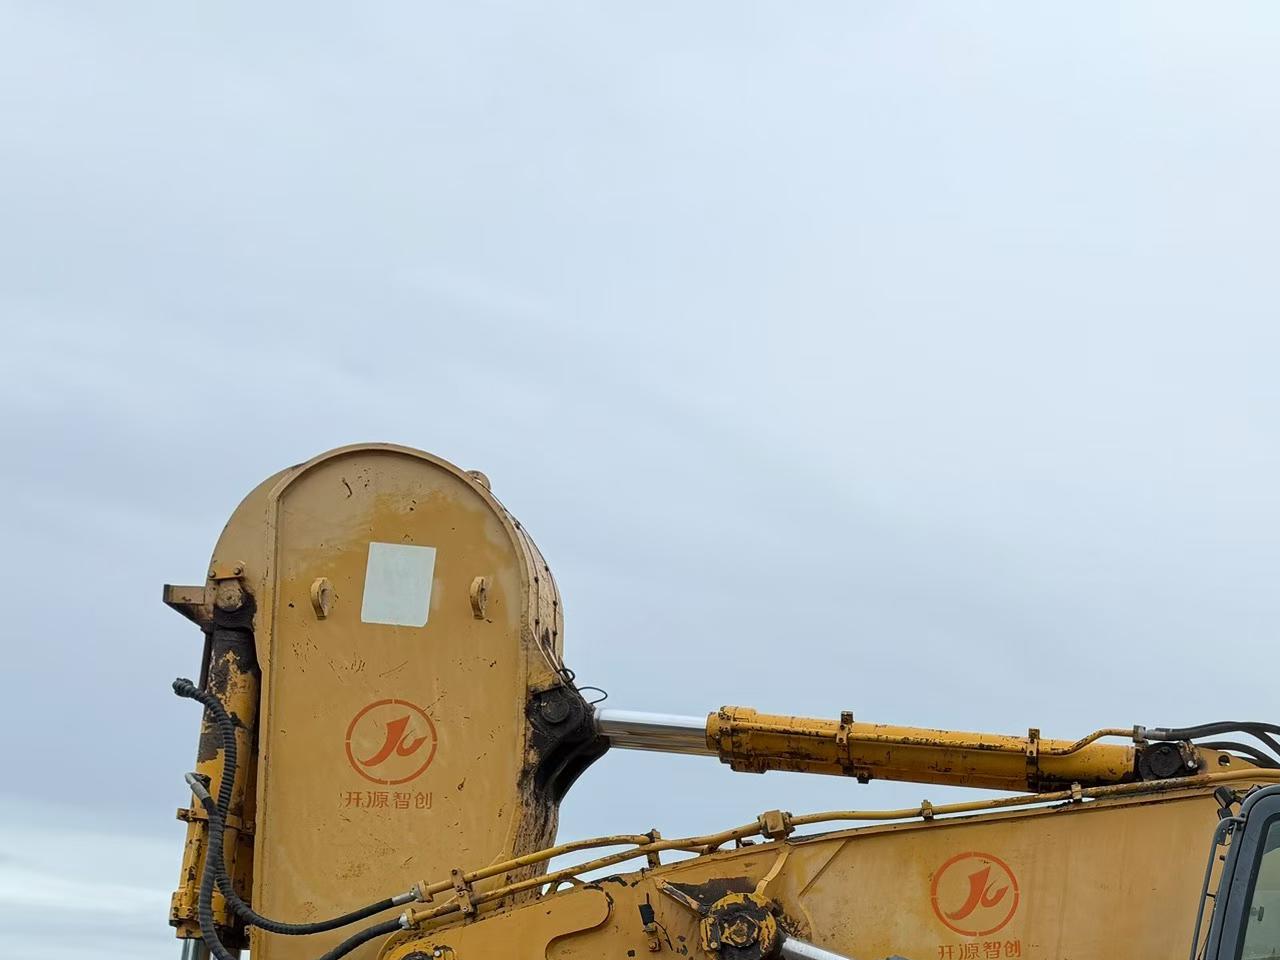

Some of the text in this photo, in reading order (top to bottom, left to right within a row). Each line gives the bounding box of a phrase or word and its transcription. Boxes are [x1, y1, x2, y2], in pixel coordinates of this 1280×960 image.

[345, 791, 433, 809] 开源智创
[938, 940, 1021, 960] 开源智创
